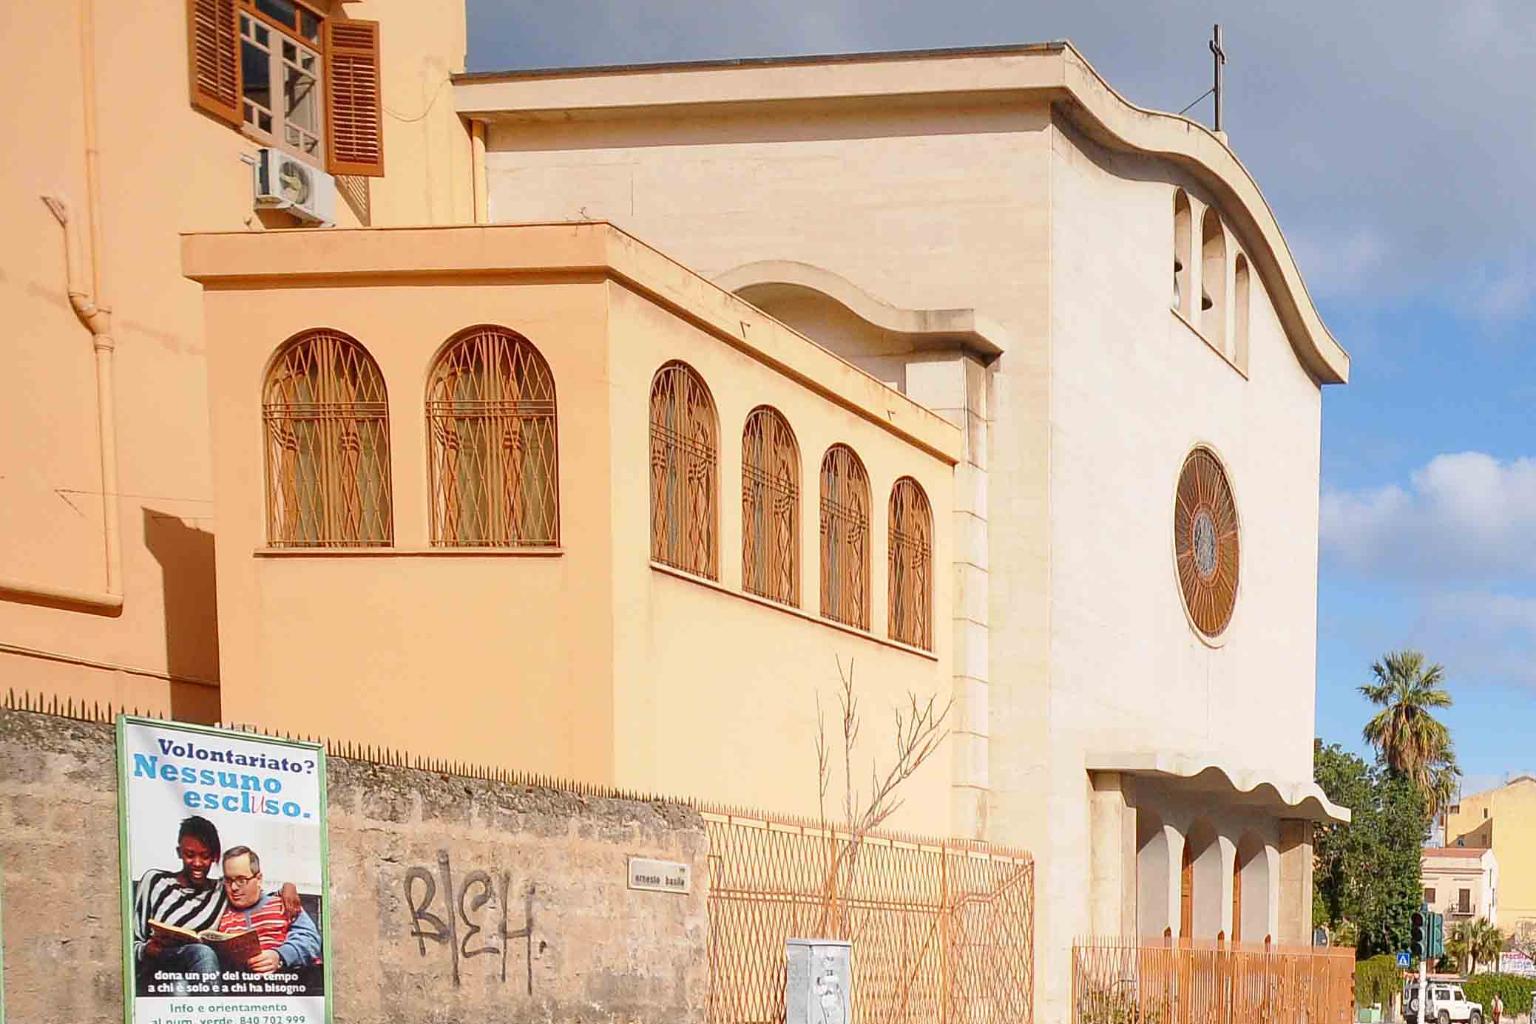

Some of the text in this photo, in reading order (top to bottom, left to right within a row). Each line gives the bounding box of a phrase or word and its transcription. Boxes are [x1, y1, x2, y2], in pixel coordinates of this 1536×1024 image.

[158, 738, 315, 775] Volontariato?
[133, 753, 282, 794] Nessuno
[183, 790, 311, 818] escluso.
[154, 971, 185, 981] dona
[185, 973, 199, 981] un
[223, 971, 240, 981] del
[242, 972, 262, 981] tuo
[263, 972, 299, 984] tempo
[148, 985, 156, 993] a
[157, 983, 174, 993] chi
[186, 983, 210, 993] solo
[212, 985, 220, 993] e
[221, 985, 229, 993] a
[231, 983, 247, 993] chi
[249, 983, 263, 993] ha
[265, 983, 306, 995] bisogno
[170, 1003, 287, 1013] Info e orientamento
[240, 1016, 260, 1024] 840
[286, 1015, 306, 1024] 999
